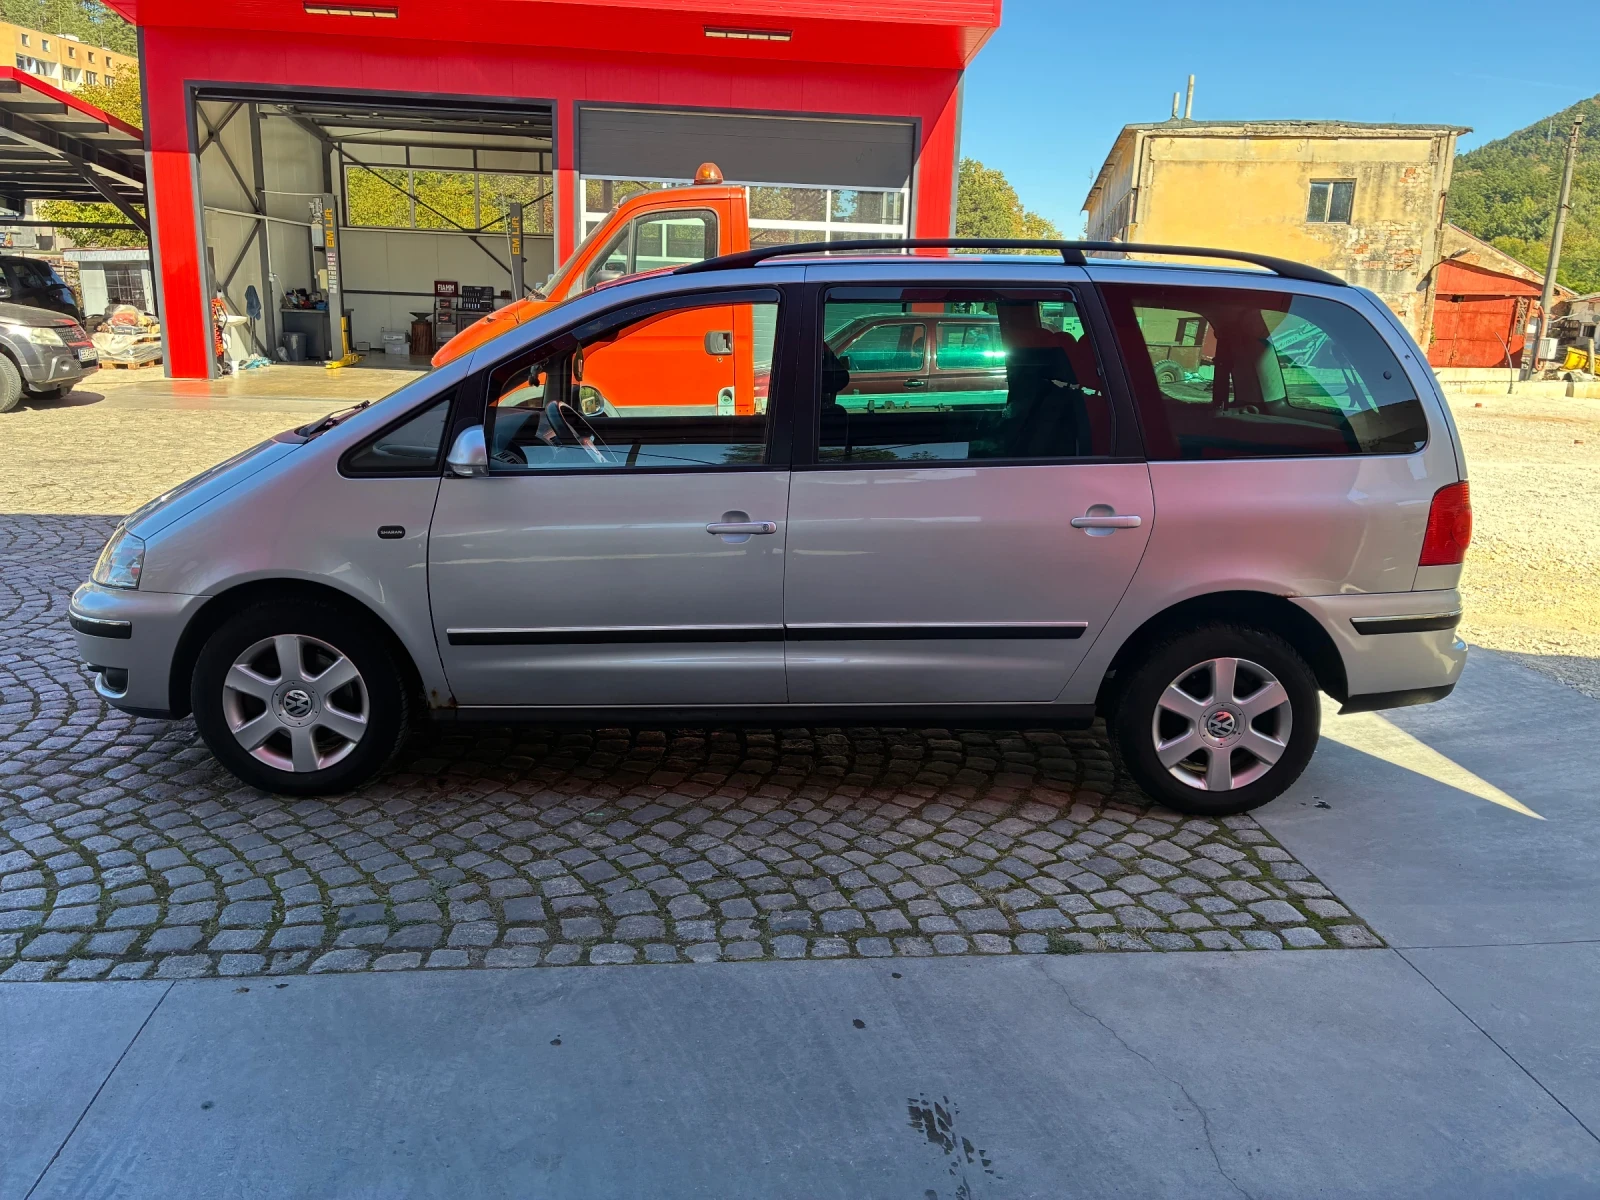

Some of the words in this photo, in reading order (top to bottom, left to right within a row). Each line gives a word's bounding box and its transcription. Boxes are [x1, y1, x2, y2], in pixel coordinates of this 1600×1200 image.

[326, 230, 335, 248] EM
[512, 238, 520, 255] EM
[437, 284, 454, 292] FIAMM
